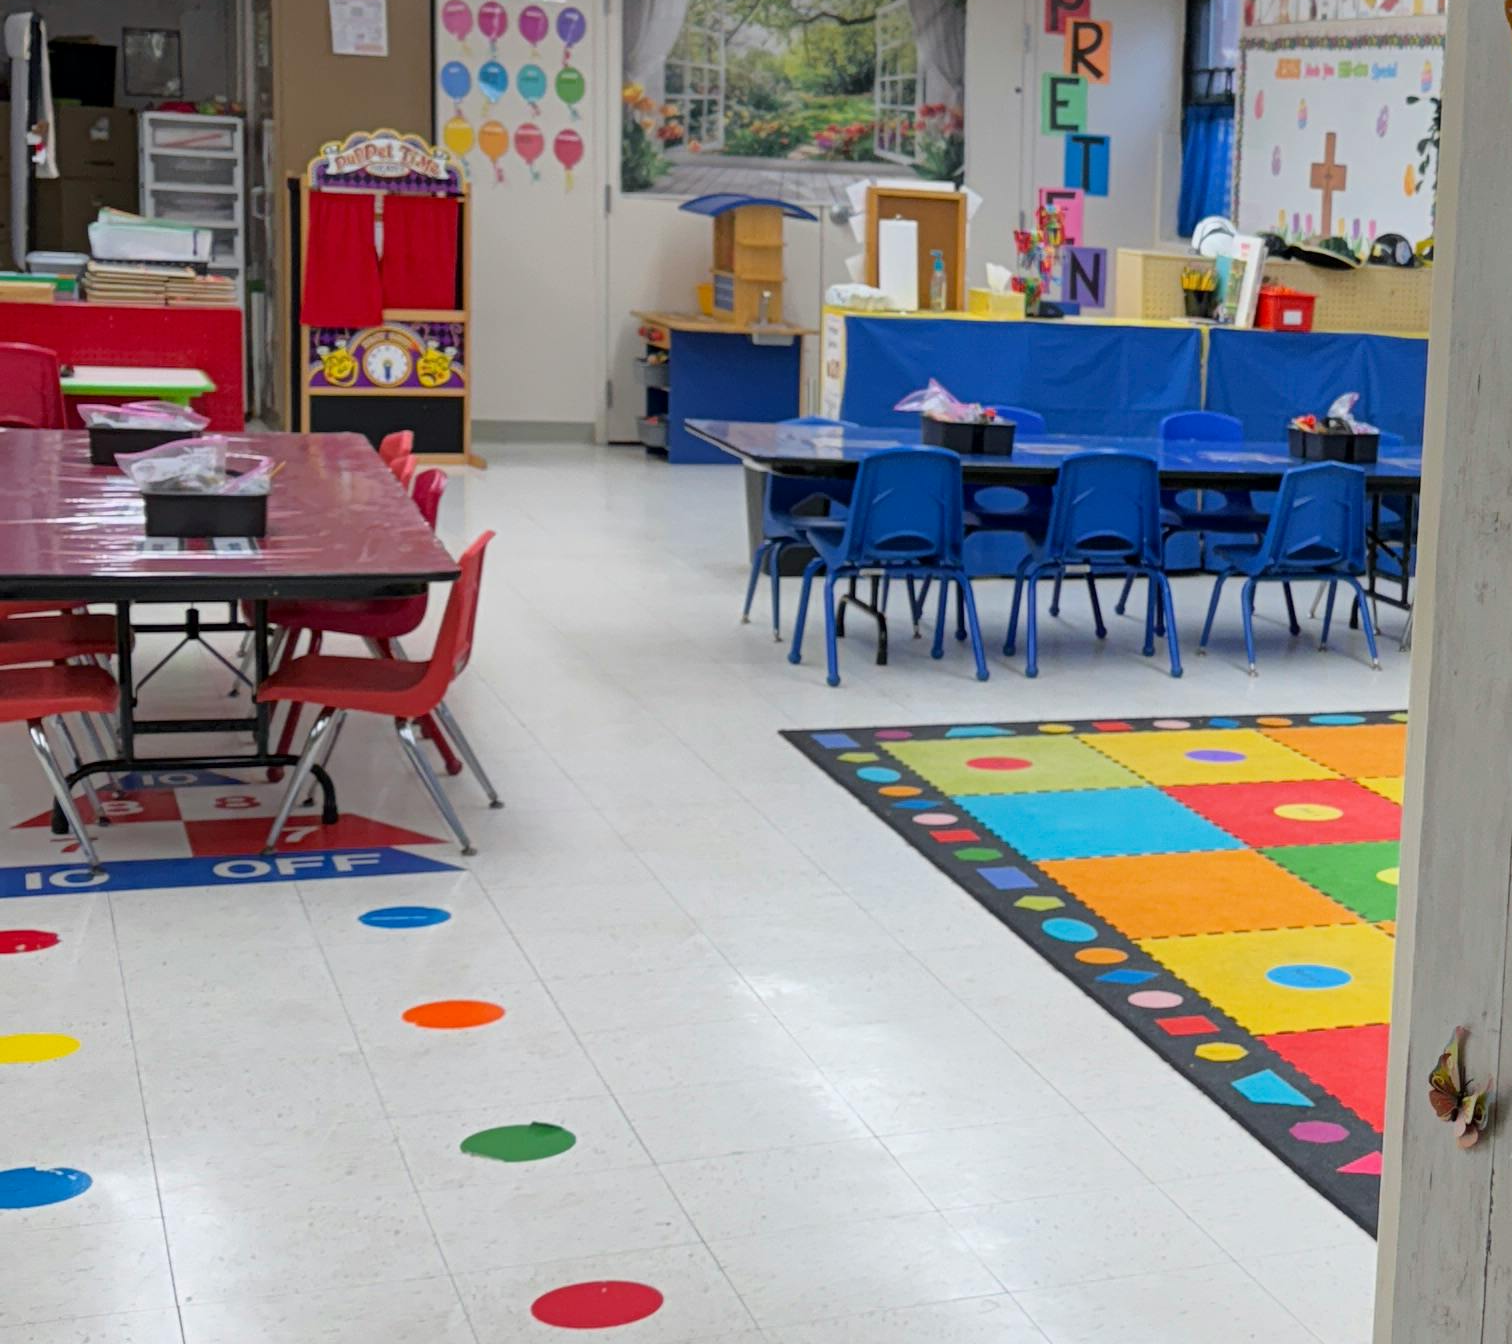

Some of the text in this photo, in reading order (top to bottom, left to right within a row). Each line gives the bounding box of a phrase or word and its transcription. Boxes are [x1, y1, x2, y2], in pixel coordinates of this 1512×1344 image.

[213, 794, 260, 810] 8
[25, 852, 382, 891] 10 OFF
